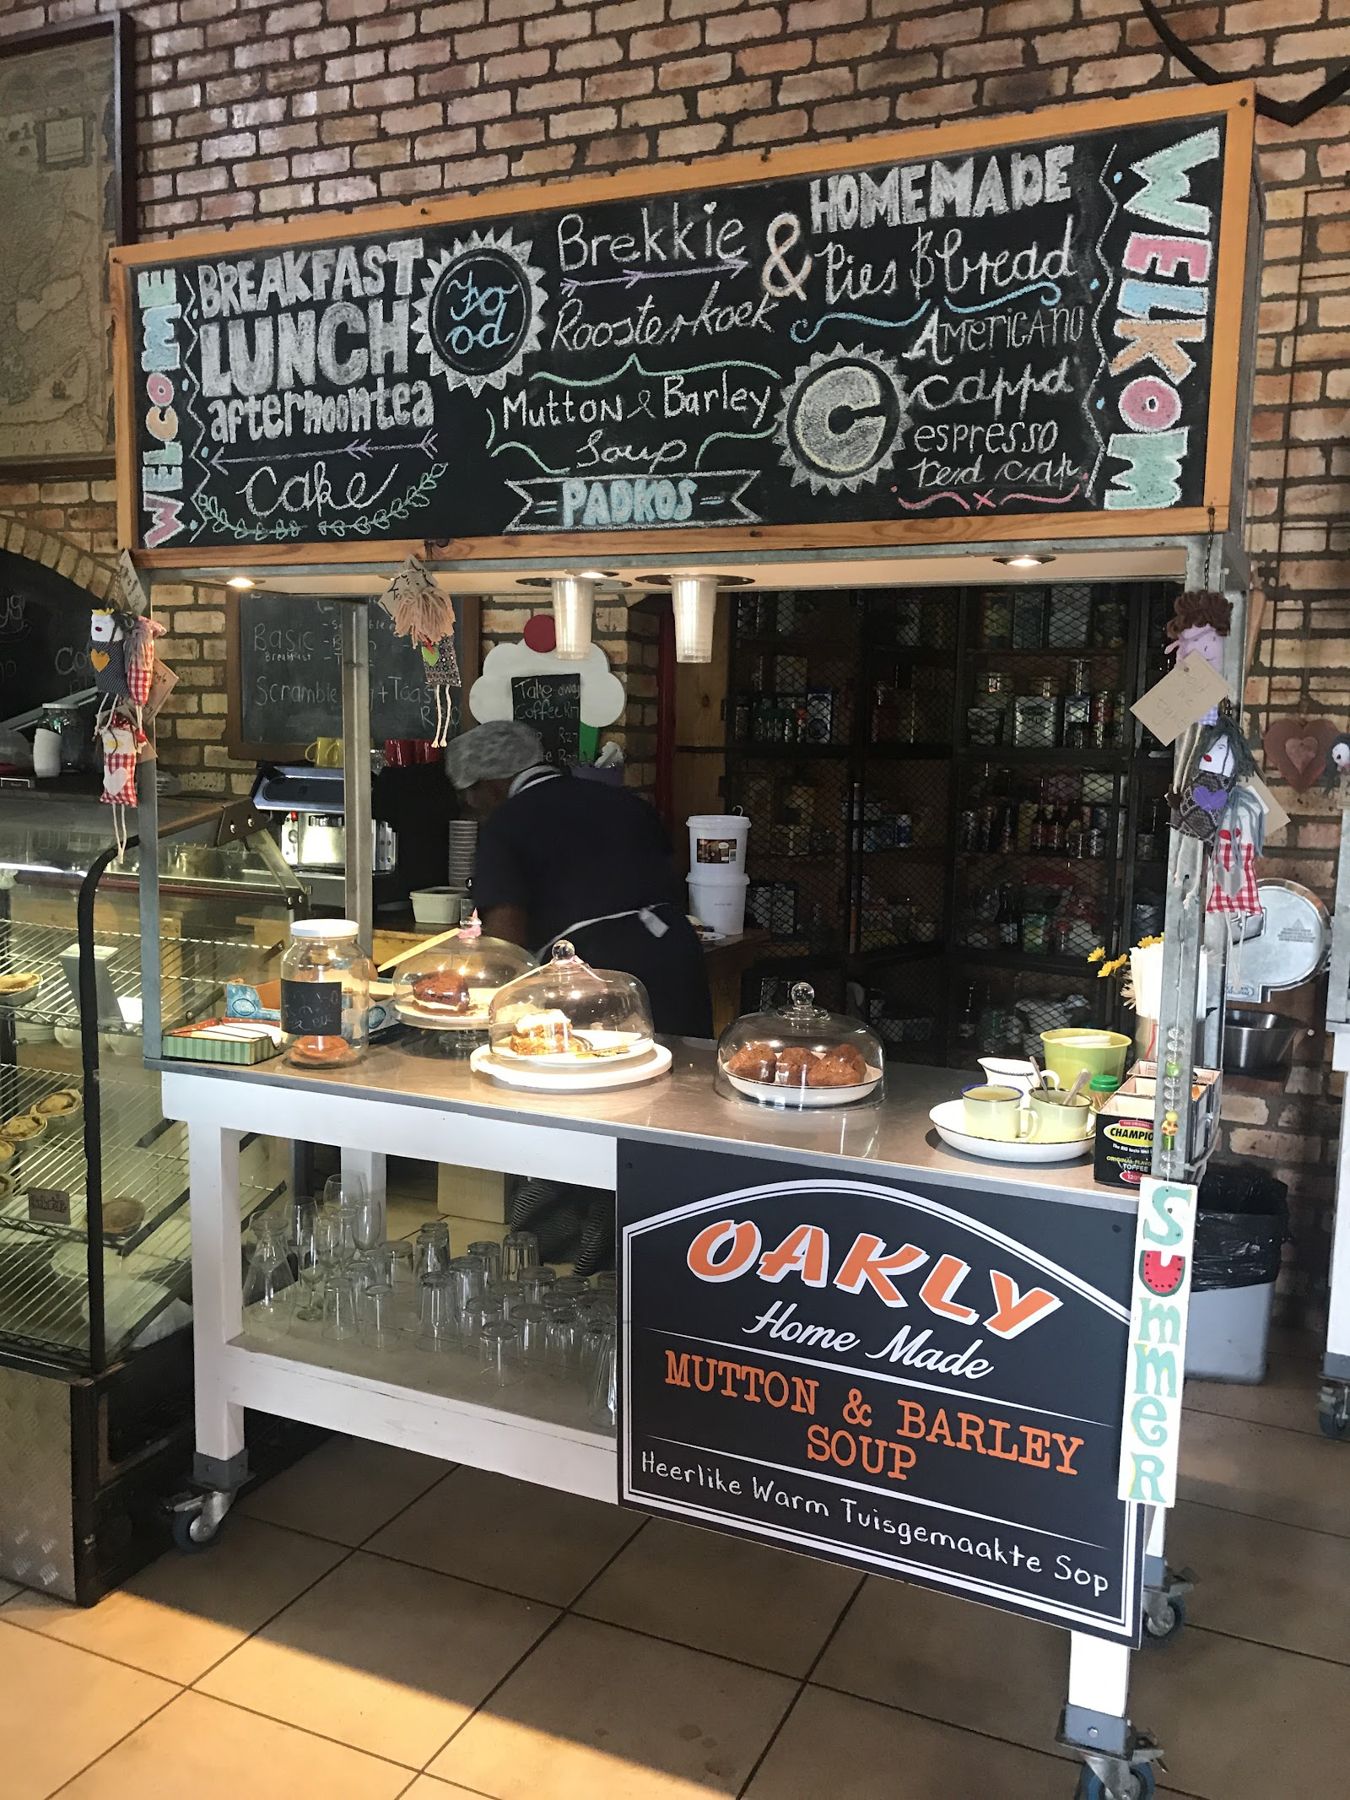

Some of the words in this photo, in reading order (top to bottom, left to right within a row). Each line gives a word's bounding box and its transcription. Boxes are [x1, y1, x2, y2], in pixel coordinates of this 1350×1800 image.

[810, 145, 1075, 234] HOMEMADE
[557, 202, 745, 271] Brekkie
[762, 212, 812, 300] &
[815, 242, 898, 304] Pies
[935, 214, 1079, 295] bread
[199, 238, 425, 318] BREAKFAST
[201, 300, 410, 396] LUNCH
[551, 281, 780, 351] Roosterkoek
[1104, 126, 1221, 510] WELKOM
[138, 269, 184, 548] WELCOME
[664, 371, 772, 428] Barley
[914, 420, 1059, 454] espresso
[576, 429, 688, 473] Soup
[235, 461, 399, 517] Cake
[562, 479, 698, 526] PADKOS
[254, 623, 314, 651] Basic
[388, 676, 436, 705] Toas
[1110, 1127, 1153, 1141] CHAMPIO
[686, 1219, 1064, 1340] OAKLY
[742, 1300, 860, 1352] Home
[866, 1324, 994, 1380] Made
[664, 1350, 820, 1416] MUTTON
[842, 1388, 873, 1426] &
[896, 1398, 1085, 1476] BARLEY
[806, 1424, 918, 1481] SOUP
[641, 1450, 742, 1496] Heerlike
[752, 1476, 830, 1517] Warm
[840, 1498, 1043, 1573] Tuisgemaakte
[1054, 1555, 1109, 1597] Sop
